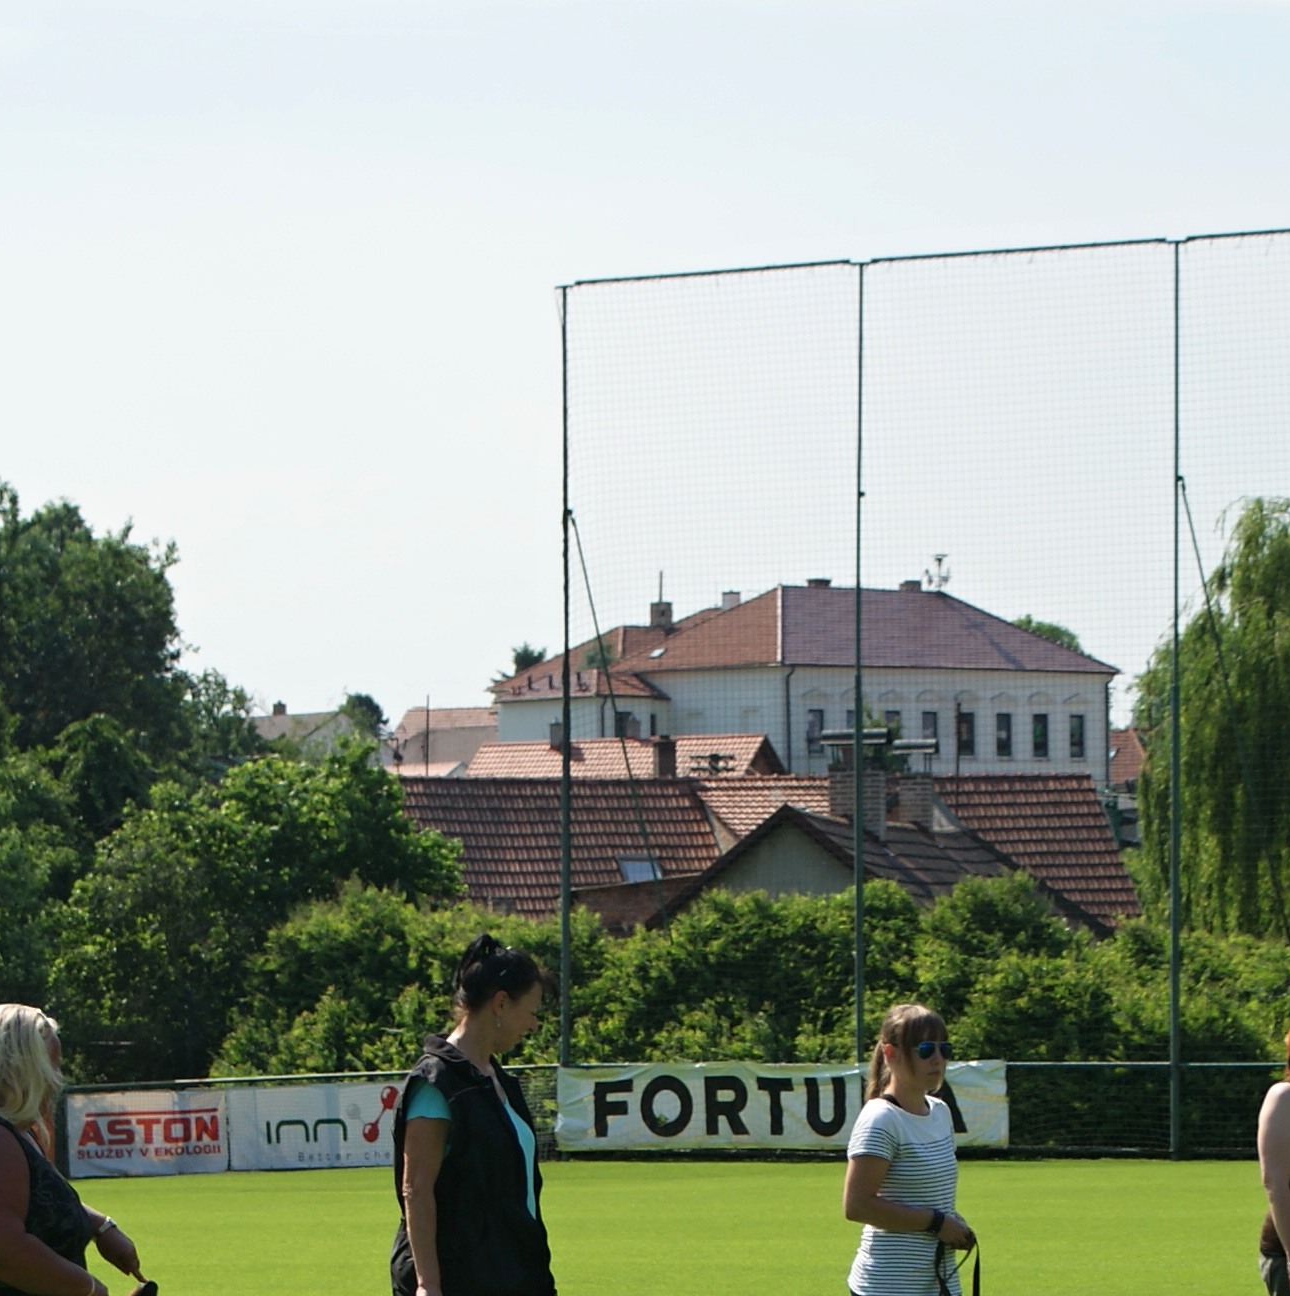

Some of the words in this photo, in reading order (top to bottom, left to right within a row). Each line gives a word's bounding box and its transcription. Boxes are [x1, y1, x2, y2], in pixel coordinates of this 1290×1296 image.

[592, 1074, 968, 1138] FORTUA
[77, 1115, 220, 1148] ASTON
[77, 1147, 134, 1161] SLUŽBY
[140, 1147, 149, 1158] V
[154, 1145, 222, 1158] EKOLOGII
[297, 1151, 353, 1163] Better
